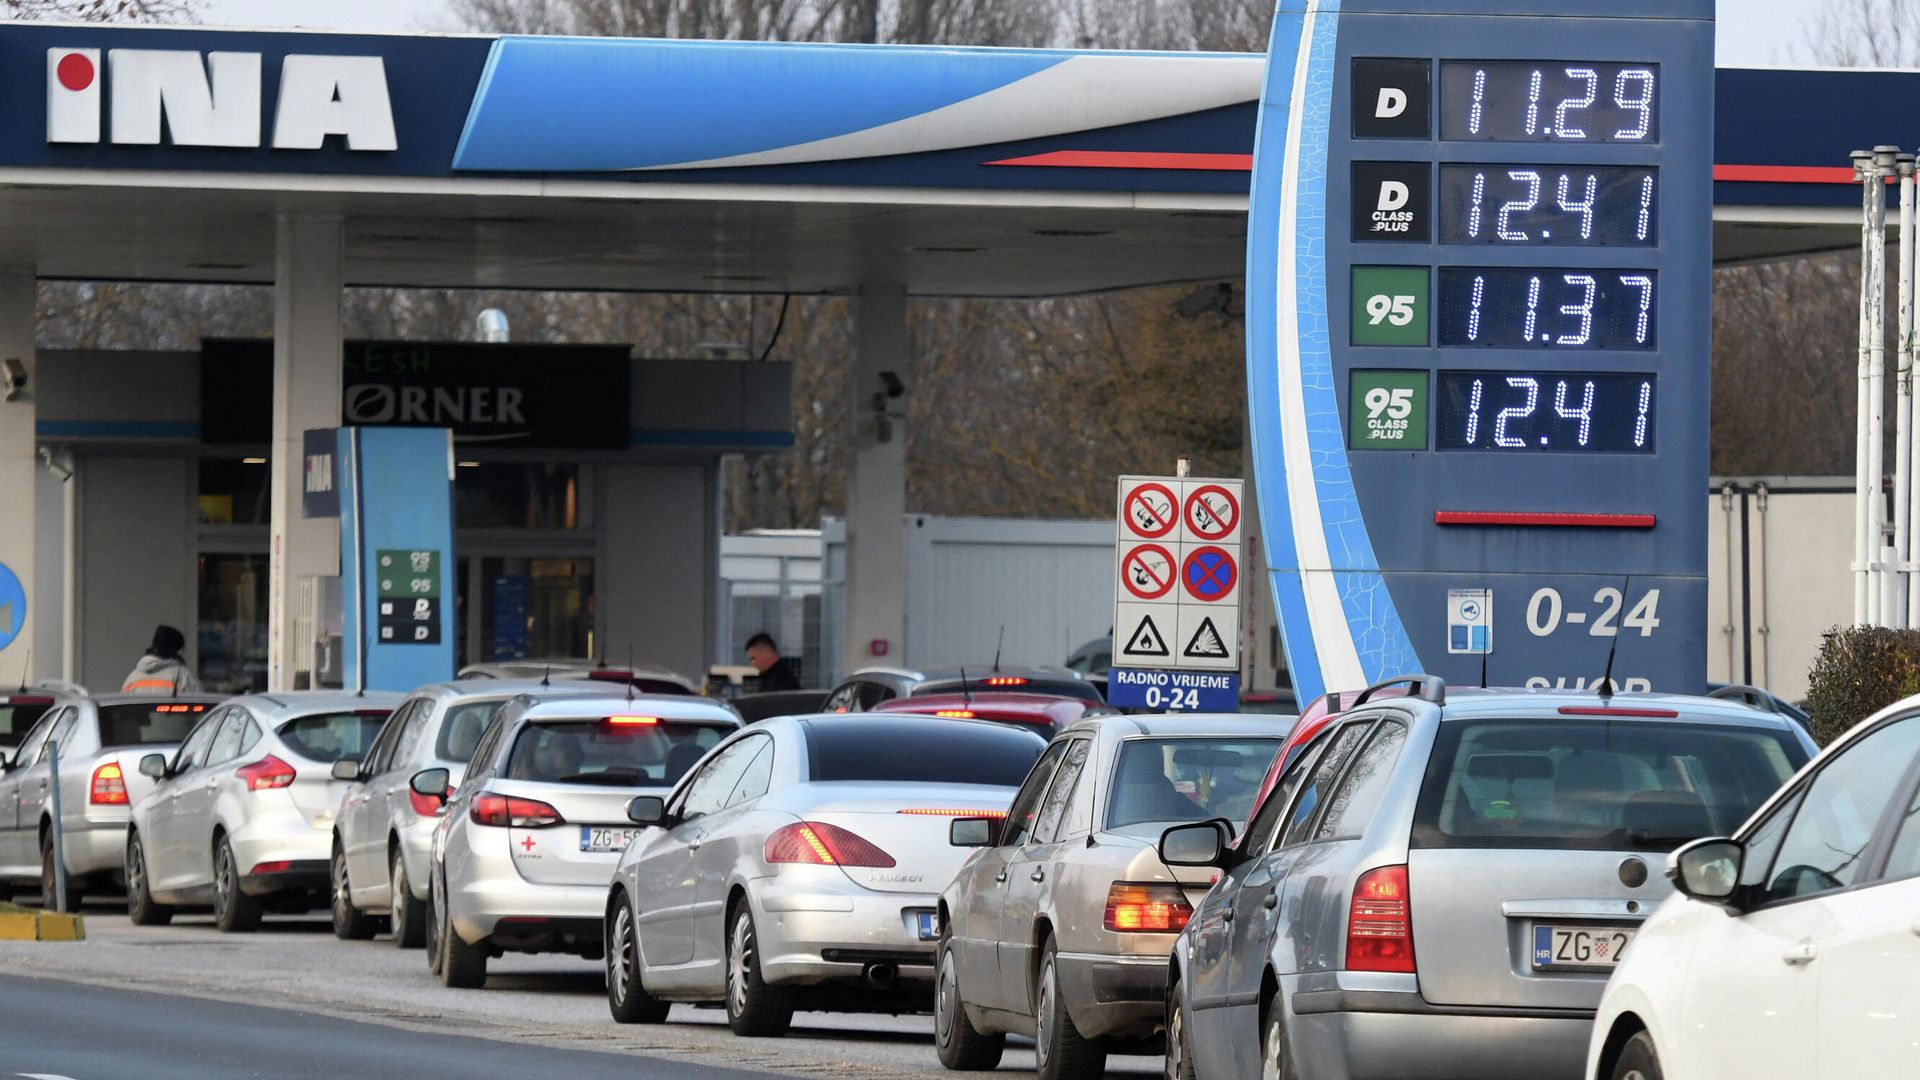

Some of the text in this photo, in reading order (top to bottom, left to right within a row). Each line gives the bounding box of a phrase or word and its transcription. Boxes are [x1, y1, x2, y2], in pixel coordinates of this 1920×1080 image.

[1375, 88, 1407, 118] D
[1469, 69, 1655, 139] 11.29
[1377, 181, 1409, 211] D
[1469, 171, 1653, 241] 12.41
[1371, 211, 1414, 222] CLASS
[1376, 222, 1409, 232] PLUS
[1366, 294, 1416, 326] 95
[1468, 275, 1652, 345] 11.37
[1364, 388, 1414, 419] 95
[1466, 377, 1651, 447] 12.41
[1367, 419, 1409, 429] CLASS
[1372, 430, 1404, 439] PLUS
[411, 579, 431, 593] 95
[415, 598, 430, 612] D
[1526, 587, 1660, 637] 0-24
[414, 625, 429, 640] D
[1117, 671, 1230, 689] RADNO VRIJEME
[1145, 686, 1200, 709] 0-24
[592, 830, 612, 847] ZG
[1536, 950, 1551, 959] HR
[1556, 931, 1591, 962] ZG
